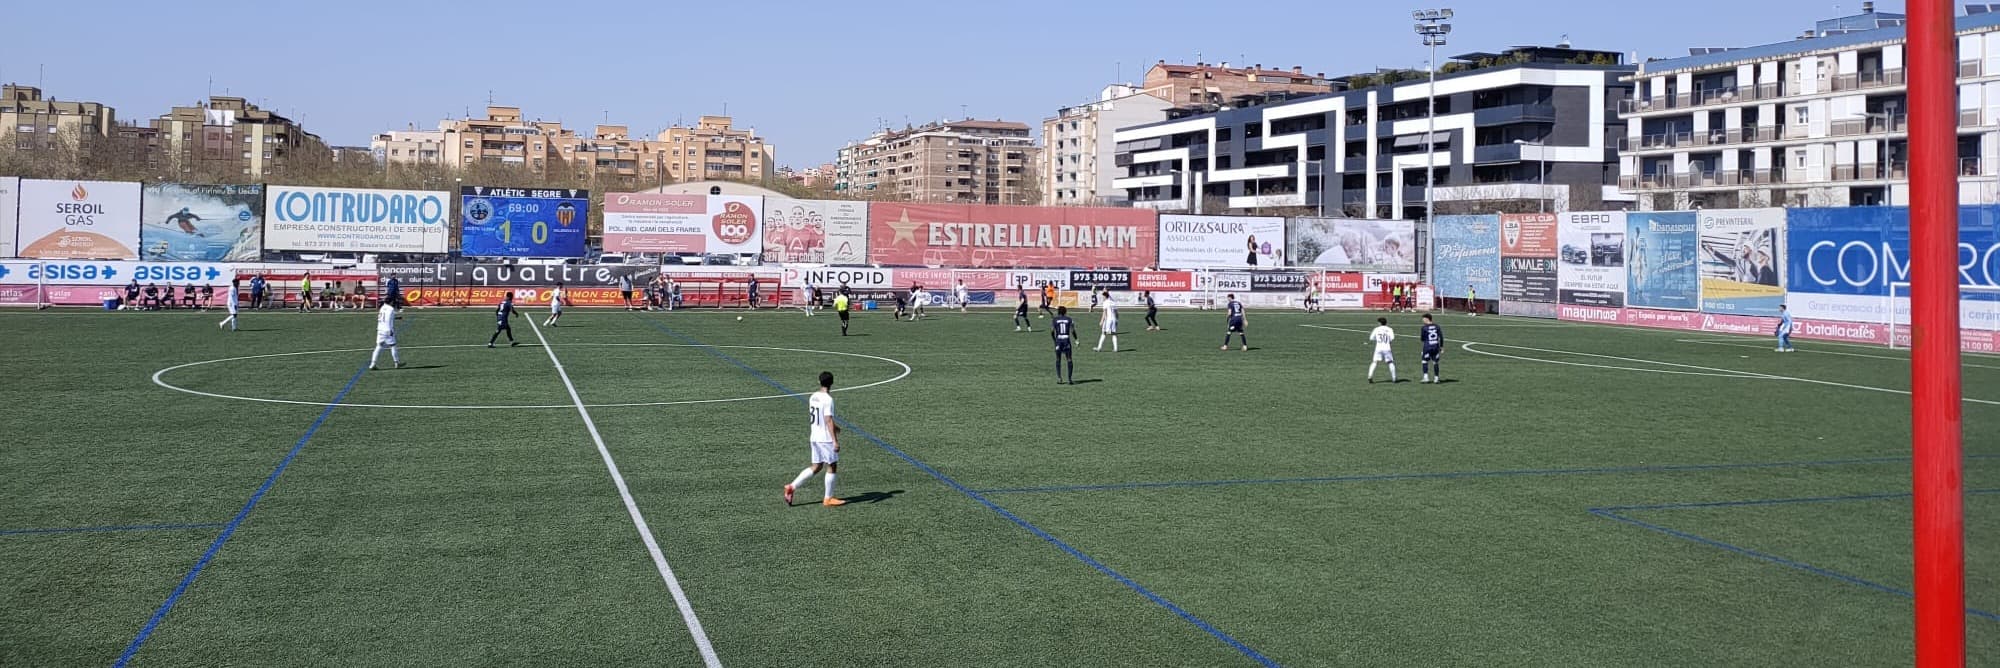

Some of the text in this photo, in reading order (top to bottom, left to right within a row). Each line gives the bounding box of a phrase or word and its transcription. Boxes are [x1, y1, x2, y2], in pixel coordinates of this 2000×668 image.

[56, 203, 104, 214] SEROIL
[275, 191, 442, 224] CONTRUDARO
[509, 203, 539, 213] 69:00
[664, 200, 694, 208] SOLER
[65, 215, 94, 225] GAS
[1572, 215, 1609, 223] EBRO
[500, 220, 511, 244] 1
[532, 221, 548, 244] 0
[721, 225, 747, 236] 100
[1165, 221, 1245, 234] ORTIZ&SAURA
[928, 222, 1137, 248] ESTRELLA DAMM
[28, 264, 97, 279] asisa
[135, 266, 201, 280] asisa
[602, 290, 639, 298] SOLR
[1808, 301, 1829, 310] Gran
[1806, 323, 1845, 337] batalla
[810, 406, 820, 426] 31
